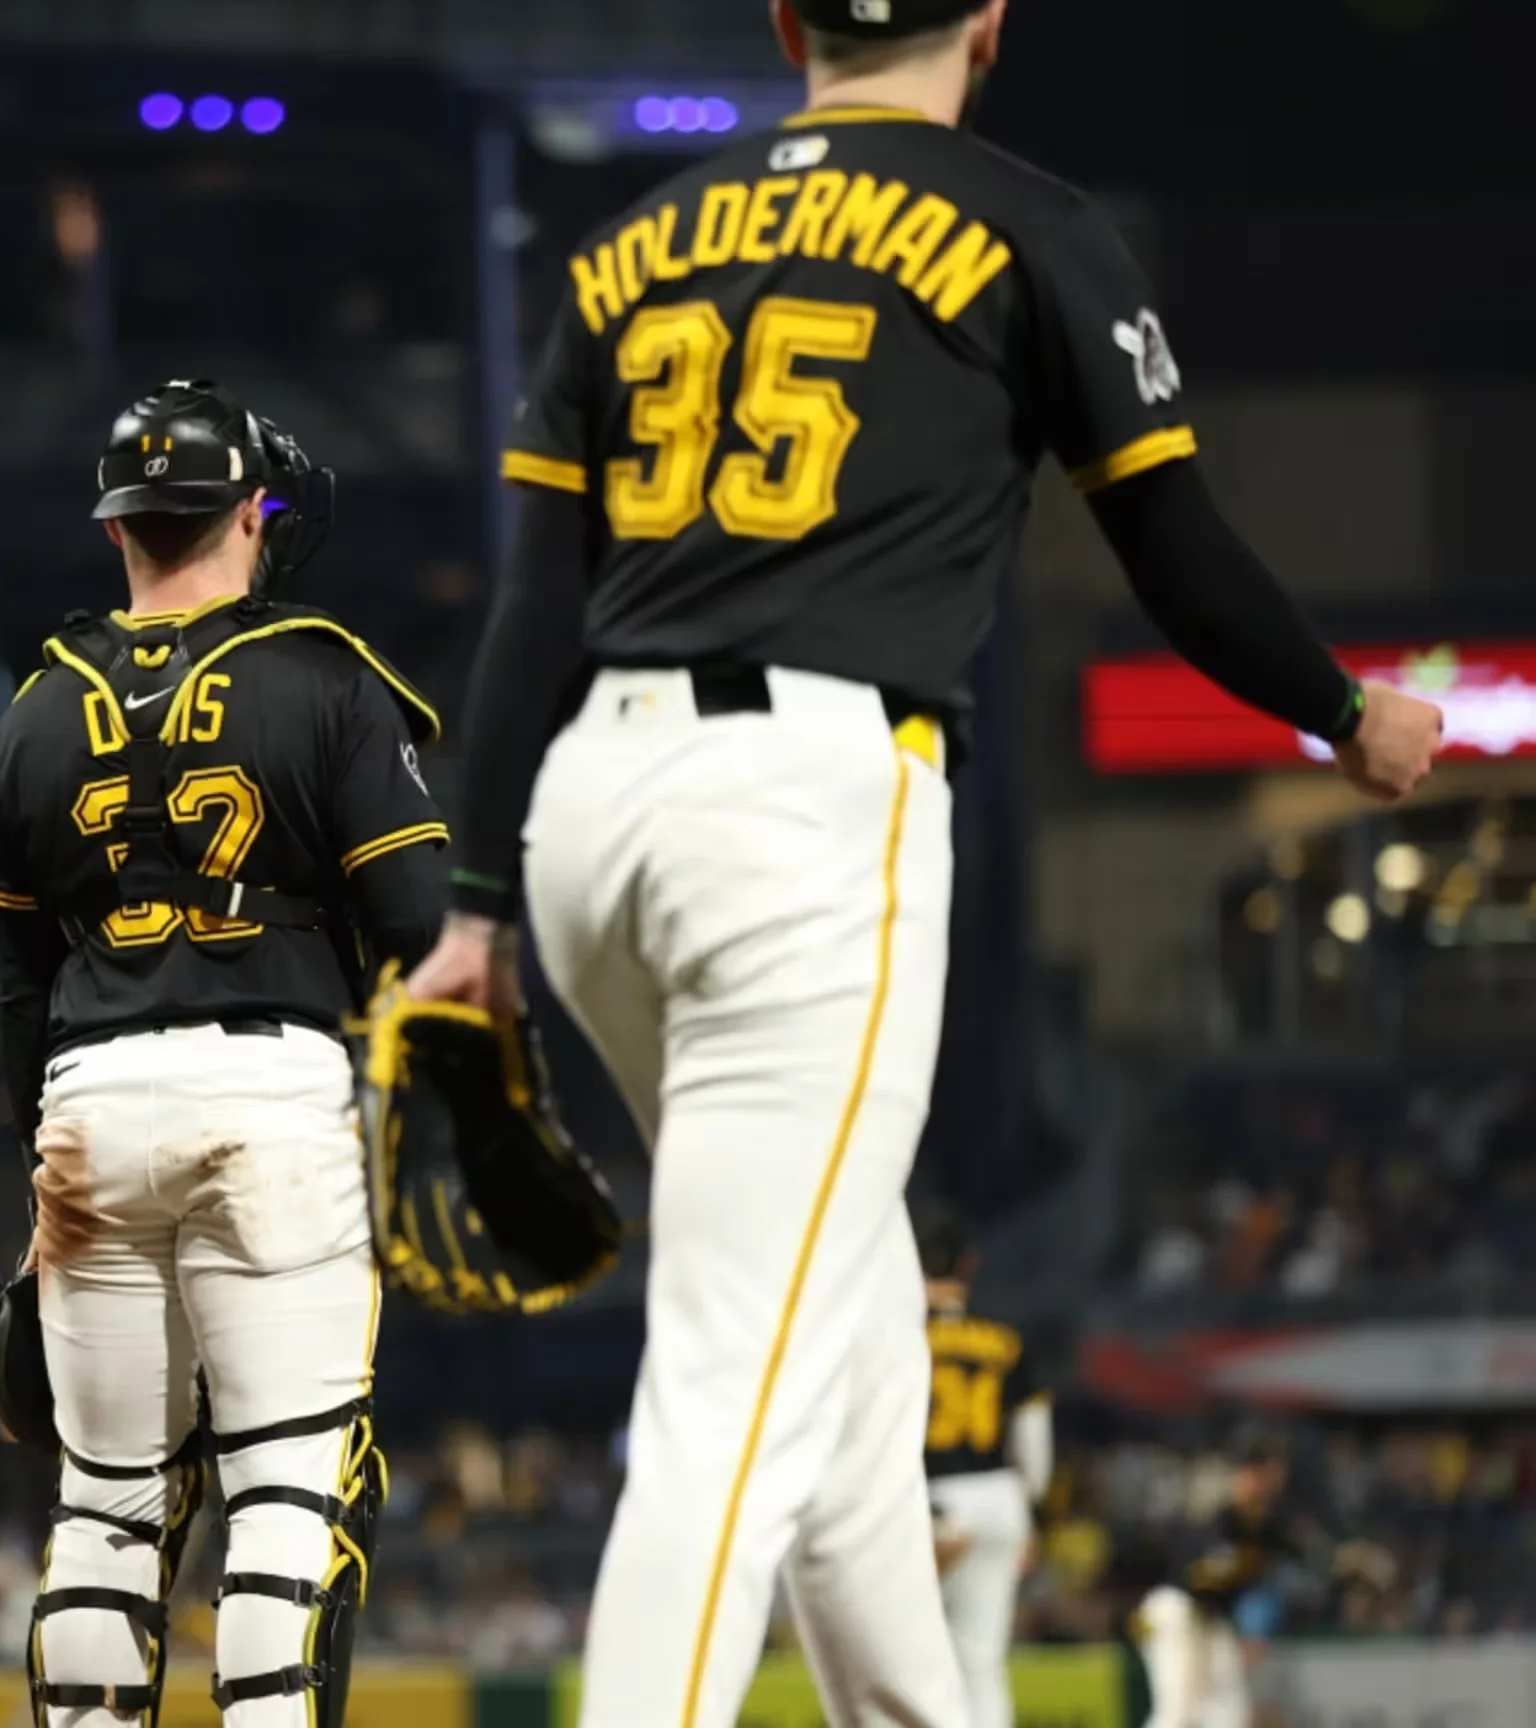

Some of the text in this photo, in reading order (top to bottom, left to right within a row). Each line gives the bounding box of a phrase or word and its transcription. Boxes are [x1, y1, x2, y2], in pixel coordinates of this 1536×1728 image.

[571, 170, 1011, 333] HOLDERMAN
[604, 297, 876, 539] 35
[83, 673, 231, 756] DIS
